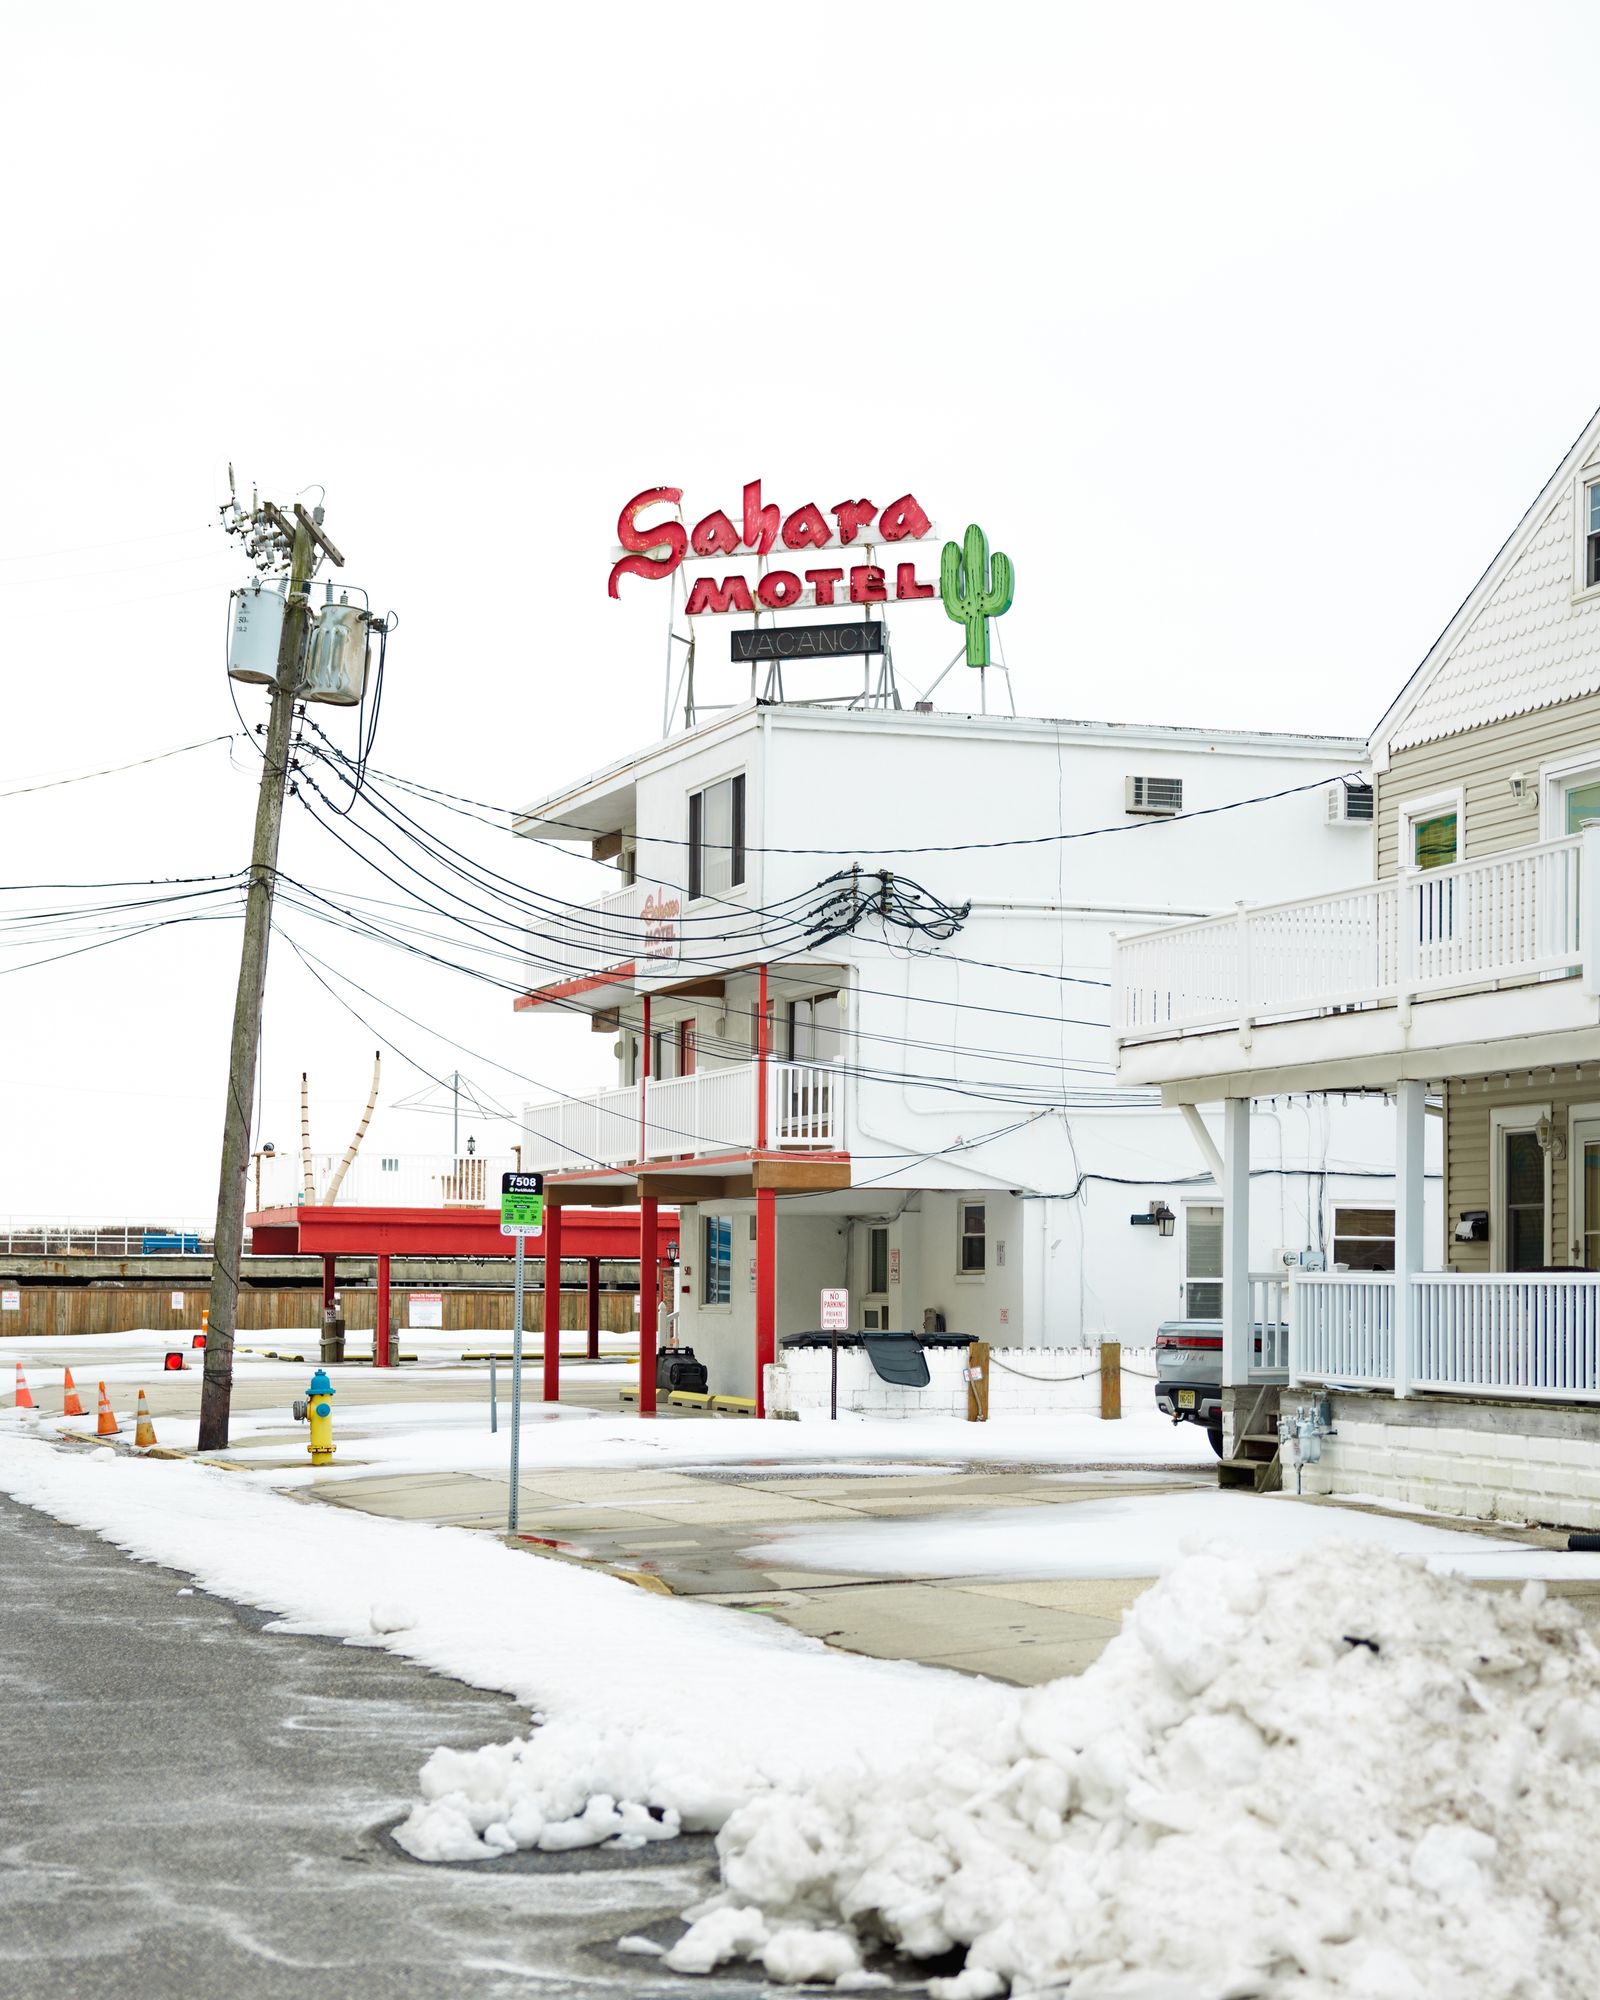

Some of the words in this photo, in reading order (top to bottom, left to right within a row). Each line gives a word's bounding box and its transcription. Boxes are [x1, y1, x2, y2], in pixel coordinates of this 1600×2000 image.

[608, 478, 932, 600] Sahara
[685, 562, 935, 615] MOTEL
[737, 626, 878, 657] VACANCY
[645, 924, 676, 948] MOTEL
[509, 1177, 537, 1187] 7508
[824, 1300, 846, 1308] PARKING
